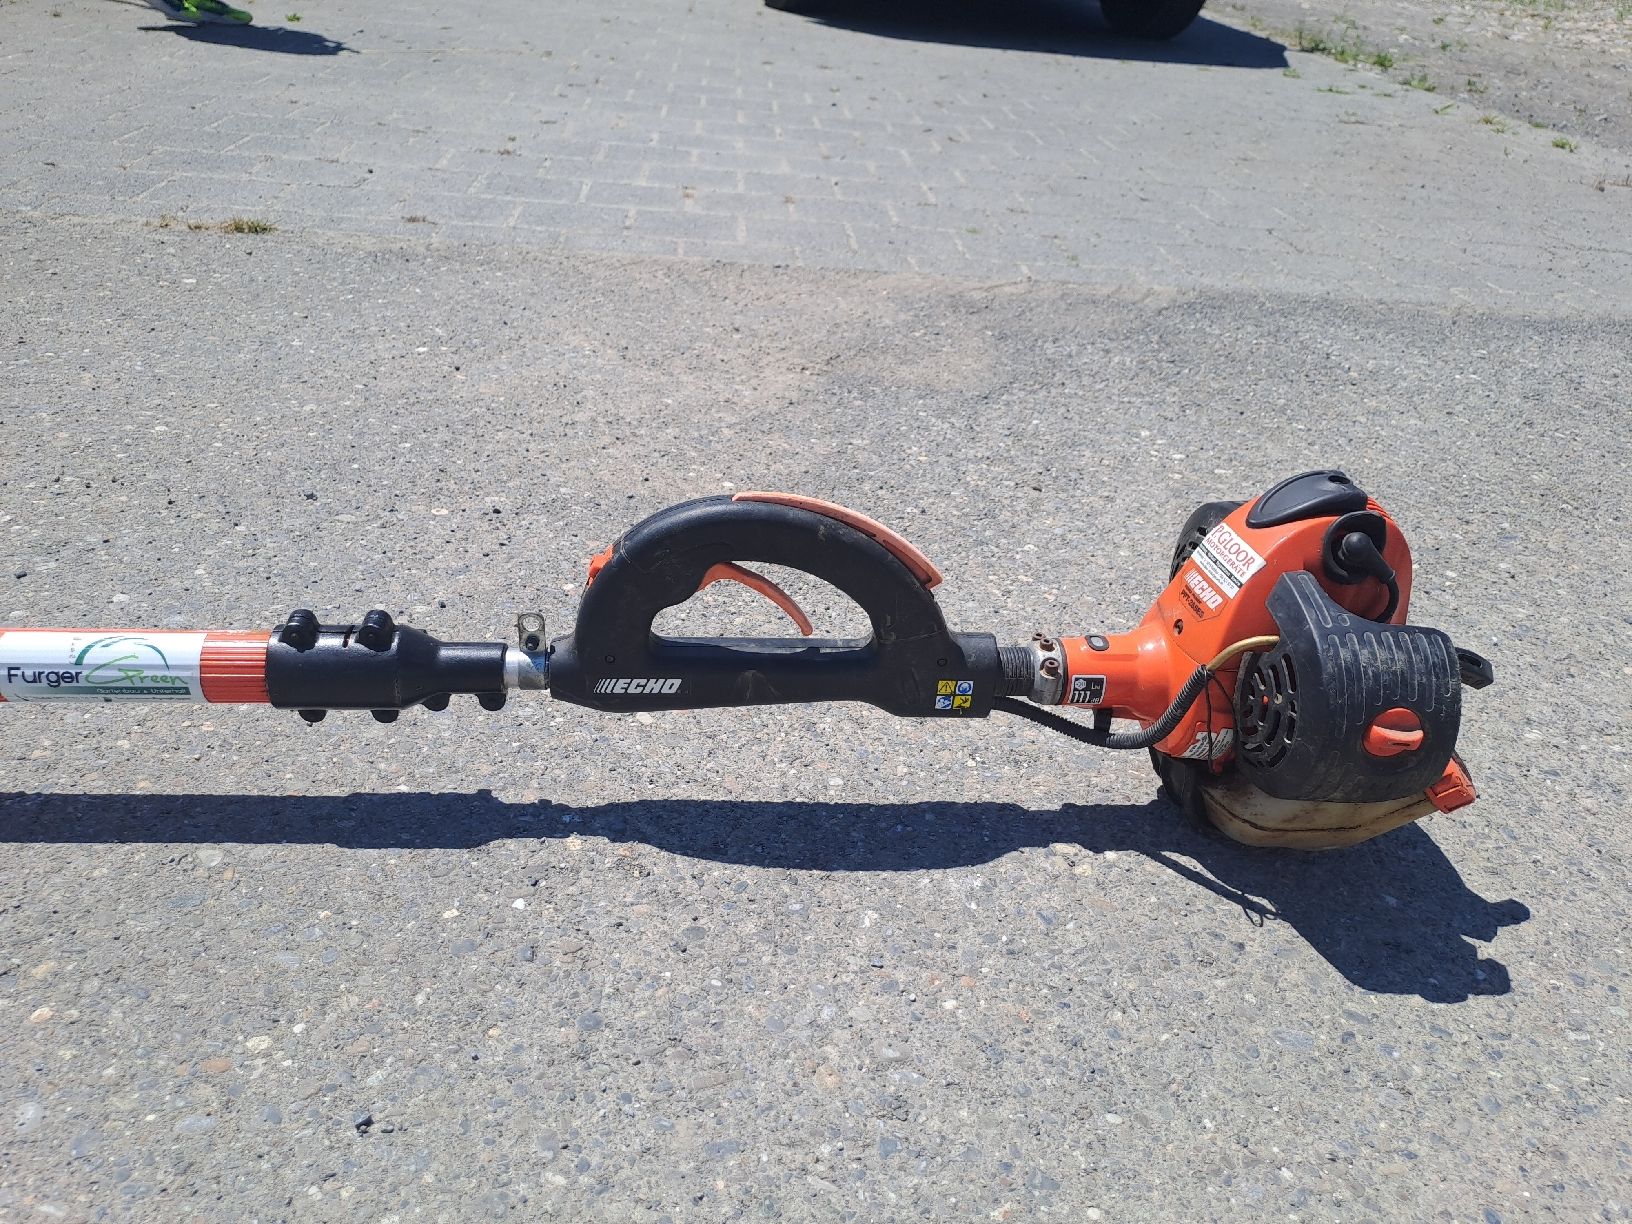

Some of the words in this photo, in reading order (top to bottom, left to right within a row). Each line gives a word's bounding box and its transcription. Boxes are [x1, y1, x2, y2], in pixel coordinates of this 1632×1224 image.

[1187, 571, 1223, 609] ECHO
[7, 666, 82, 687] Furger
[611, 679, 682, 693] ECHO
